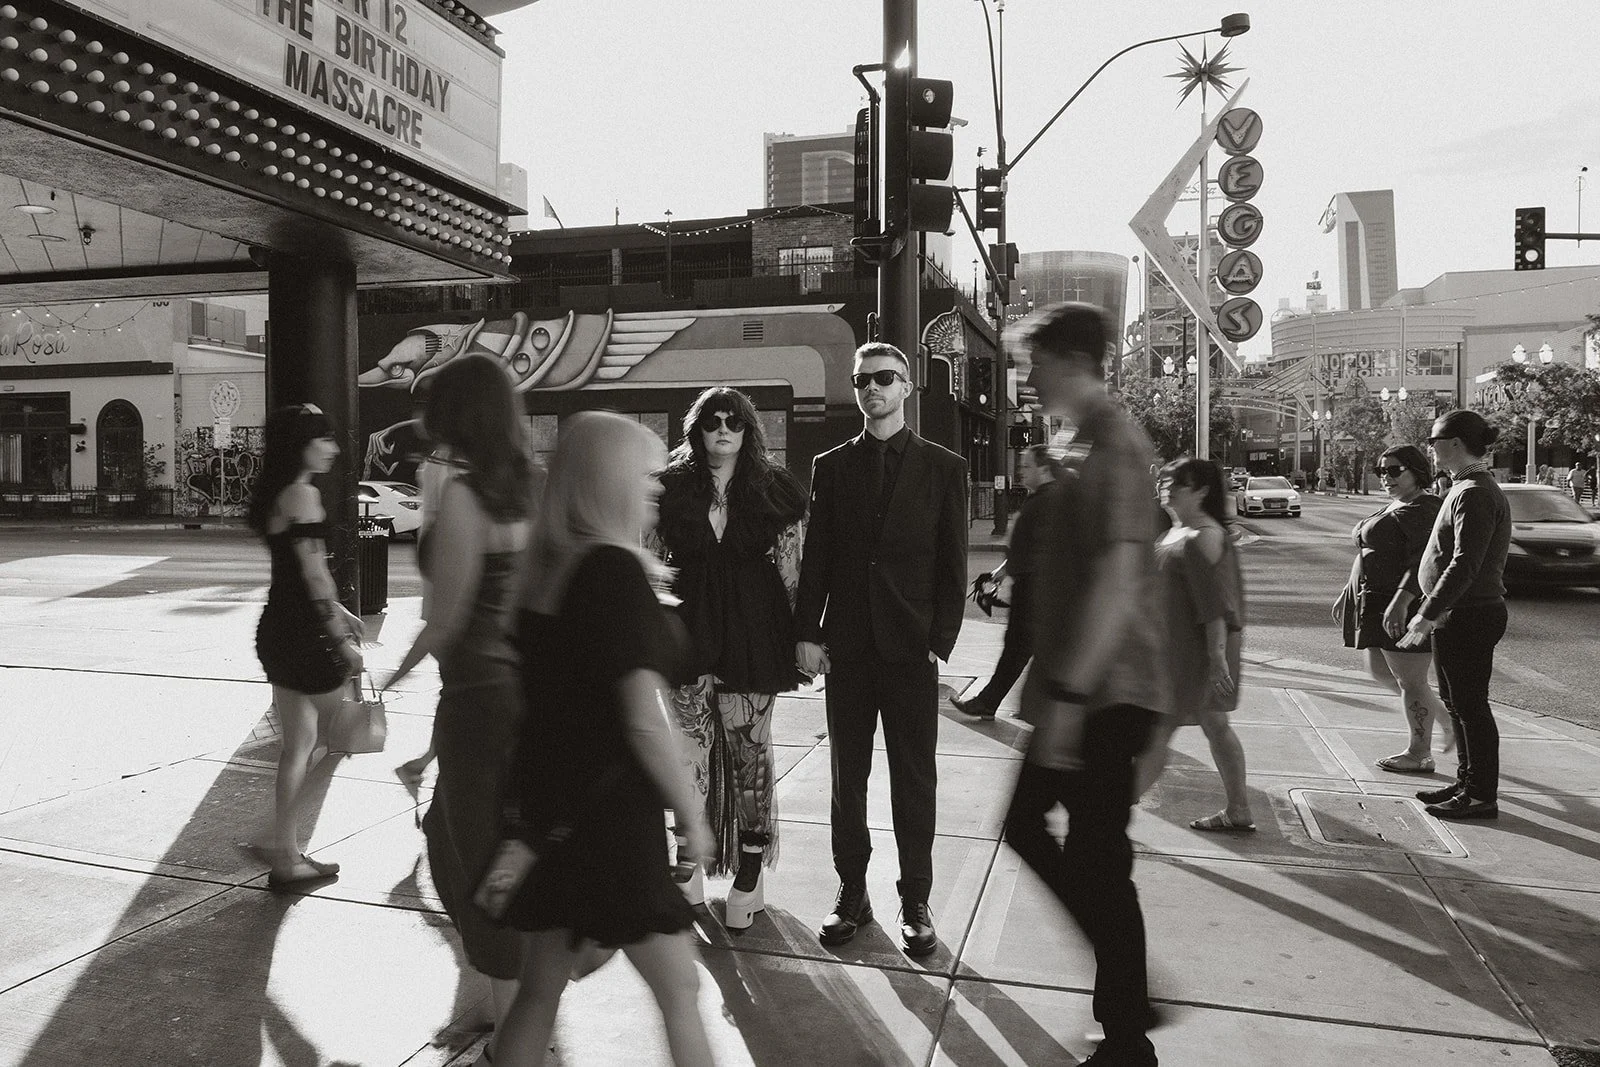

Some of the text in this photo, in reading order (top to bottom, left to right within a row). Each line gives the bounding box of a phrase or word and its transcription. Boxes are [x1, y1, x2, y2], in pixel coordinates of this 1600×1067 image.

[285, 43, 423, 150] MASSACRE
[335, 14, 450, 113] BIRTHDAY
[1220, 111, 1263, 338] VEGAS
